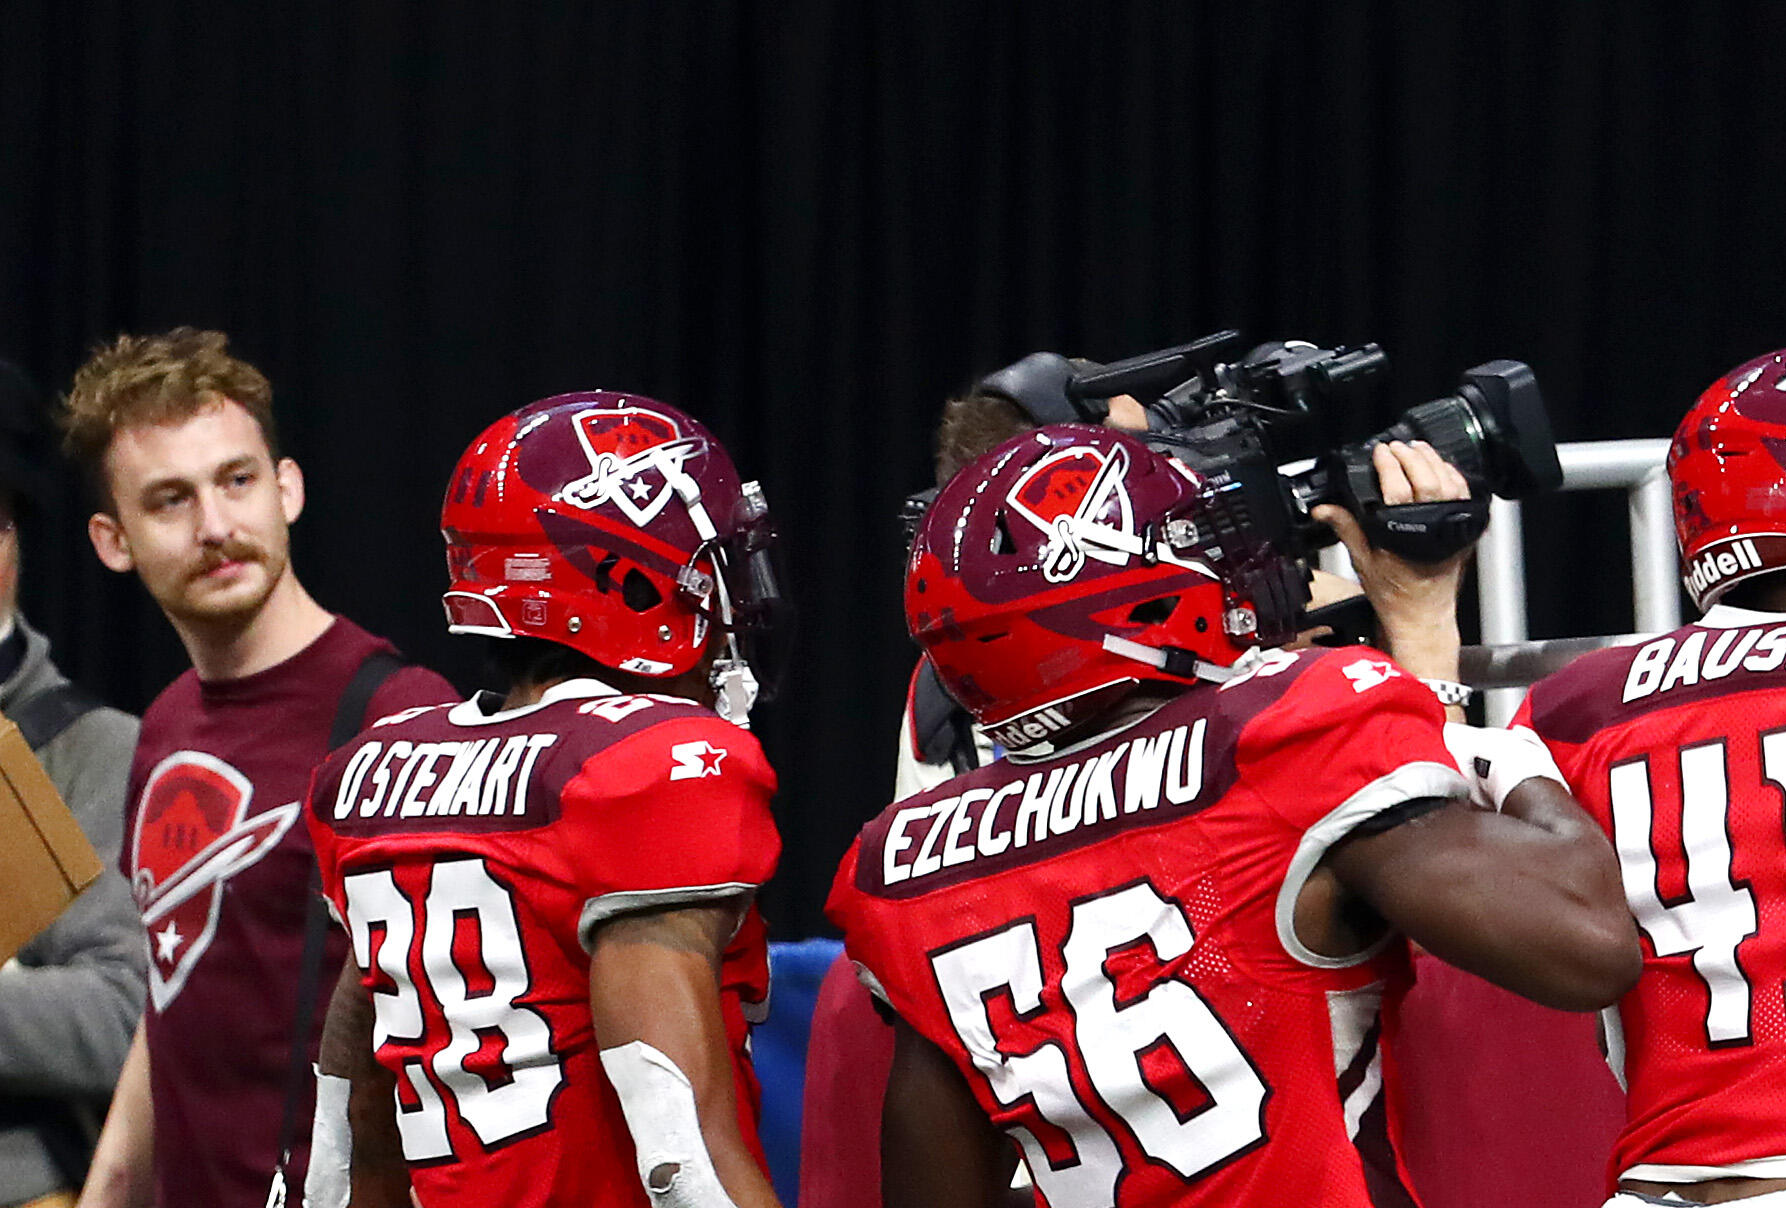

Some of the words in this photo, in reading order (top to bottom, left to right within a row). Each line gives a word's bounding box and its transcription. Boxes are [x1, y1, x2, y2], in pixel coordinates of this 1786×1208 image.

[1684, 538, 1763, 606] iddell
[992, 706, 1072, 749] ddell
[883, 717, 1208, 886] EZECHUKWU
[343, 857, 564, 1163] 28
